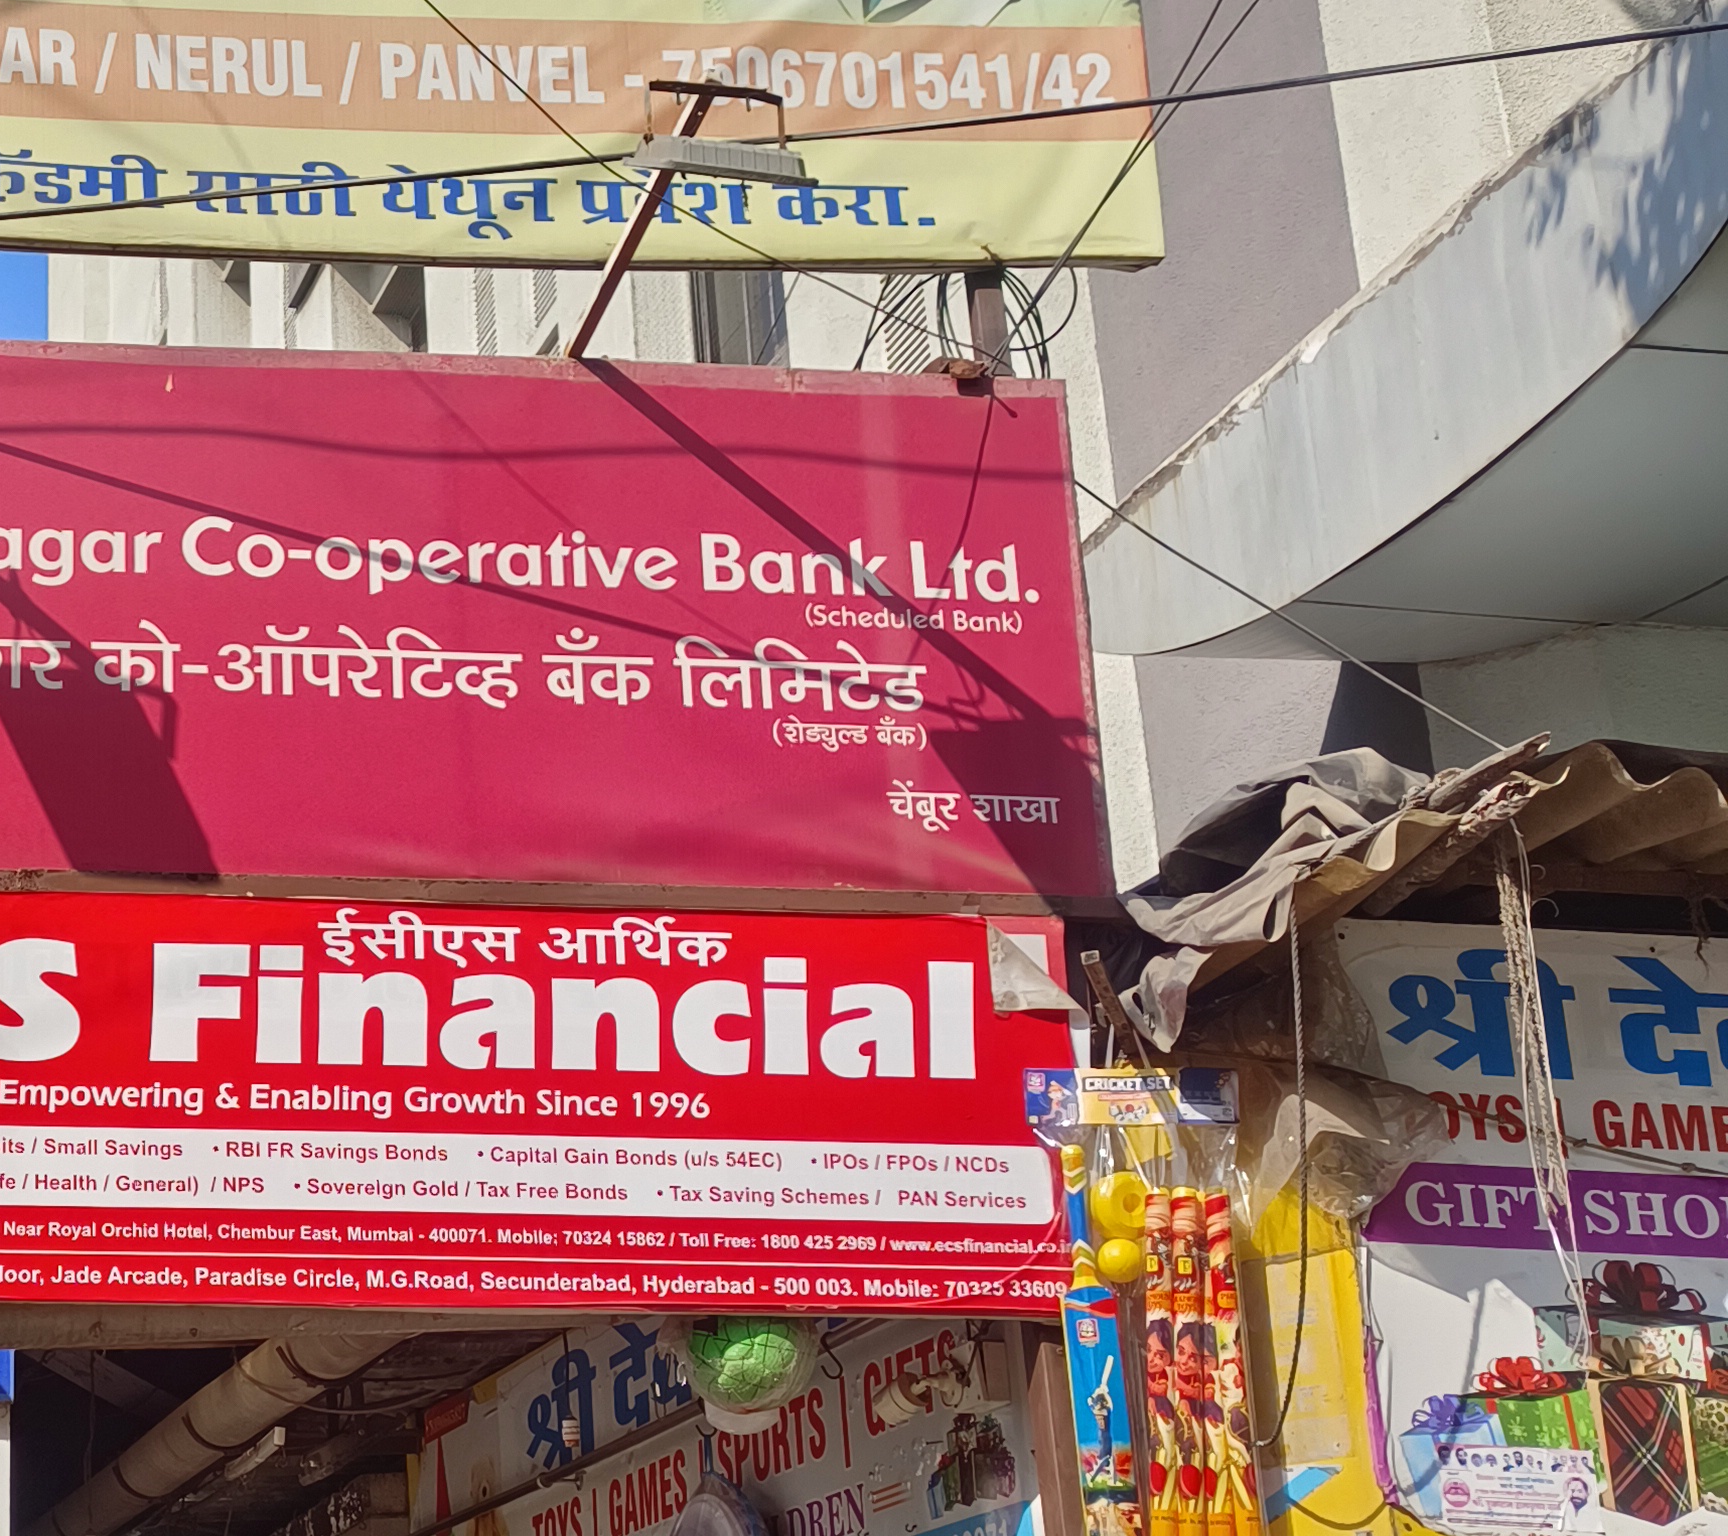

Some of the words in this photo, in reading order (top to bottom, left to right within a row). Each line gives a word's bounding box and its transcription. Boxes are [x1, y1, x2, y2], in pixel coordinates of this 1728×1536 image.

[136, 34, 322, 100] NERUL
[381, 43, 606, 104] PANVEL
[382, 163, 556, 240] येथून
[181, 515, 677, 594] Co-operative
[701, 532, 894, 597] Bank
[911, 539, 1040, 604] Ltd.
[804, 602, 945, 633] (Scheduled
[953, 605, 1024, 635] Bank)
[542, 626, 653, 708] बँक
[674, 634, 927, 713] लिमिटेड
[971, 792, 1060, 826] शाखा
[319, 908, 520, 967] ईसीएस
[538, 916, 732, 967] आर्थिक
[150, 942, 977, 1080] Financial
[249, 1085, 393, 1119] Enabling
[403, 1088, 526, 1118] Growth
[536, 1090, 618, 1119] Since
[632, 1093, 711, 1120] 1996
[1085, 1077, 1143, 1090] CRICKET
[1146, 1077, 1171, 1090] SET
[44, 1138, 97, 1156] Small
[105, 1140, 183, 1159] Savings
[301, 1142, 378, 1164] Savings
[386, 1144, 448, 1162] Bonds
[491, 1147, 557, 1166] Capital
[565, 1148, 608, 1165] Gain
[616, 1149, 677, 1166] Bonds
[887, 1155, 938, 1172] FPOs
[956, 1156, 1009, 1173] NCDs
[34, 1174, 96, 1191] Health
[116, 1175, 198, 1195] General)
[307, 1178, 405, 1199] Sovereign
[413, 1180, 459, 1198] Gold
[477, 1181, 509, 1198] Tax
[516, 1182, 558, 1199] Free
[566, 1183, 628, 1200] Bonds
[670, 1185, 702, 1202] Tax
[709, 1186, 775, 1206] Saving
[781, 1188, 869, 1206] Schemes
[898, 1190, 938, 1207] PAN
[944, 1191, 1026, 1209] Services
[1405, 1180, 1554, 1231] GIFT
[101, 1222, 158, 1238] Orchid
[348, 1226, 413, 1242] Mumbai
[51, 1266, 101, 1284] Jade
[108, 1267, 188, 1288] Arcade,
[194, 1268, 286, 1286] Paradise
[293, 1269, 359, 1291] Circle,
[367, 1270, 474, 1292] M.G.Road,
[481, 1271, 637, 1295] Secunderabad,
[643, 1274, 755, 1296] Hyderabad
[774, 1278, 810, 1295] 500
[717, 1386, 827, 1490] SPORTS
